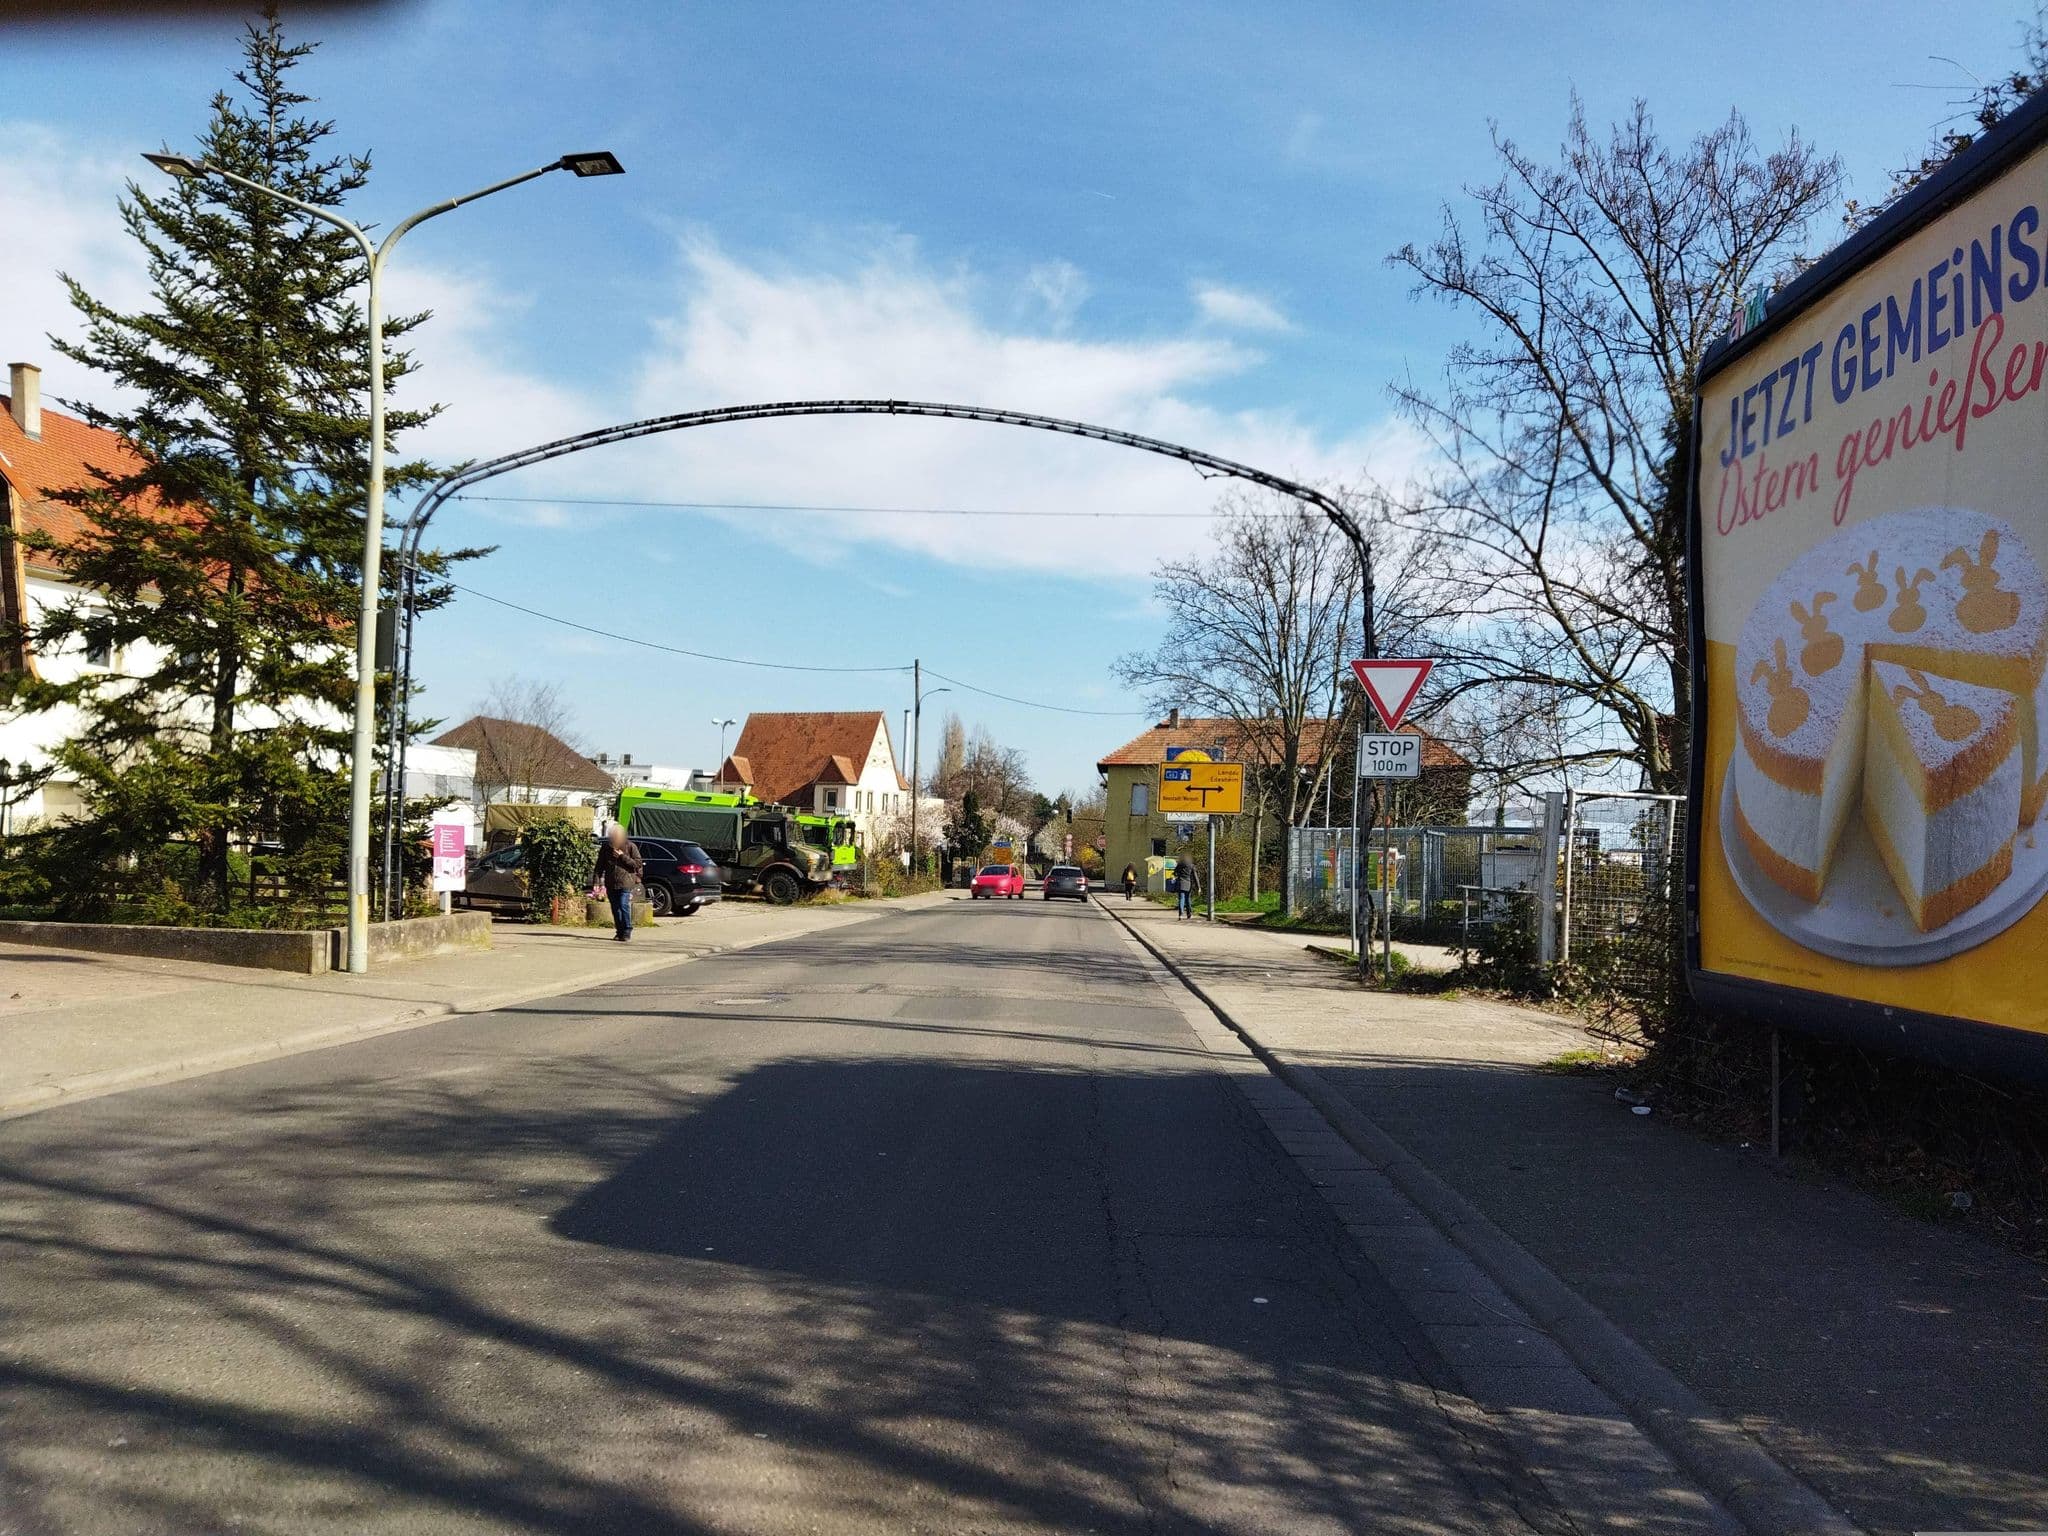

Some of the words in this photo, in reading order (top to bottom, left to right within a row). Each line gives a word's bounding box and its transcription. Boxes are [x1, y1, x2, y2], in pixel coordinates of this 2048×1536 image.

[1720, 341, 1823, 469] JETZT
[1717, 452, 1819, 537] Ostern
[1367, 740, 1414, 756] STOP
